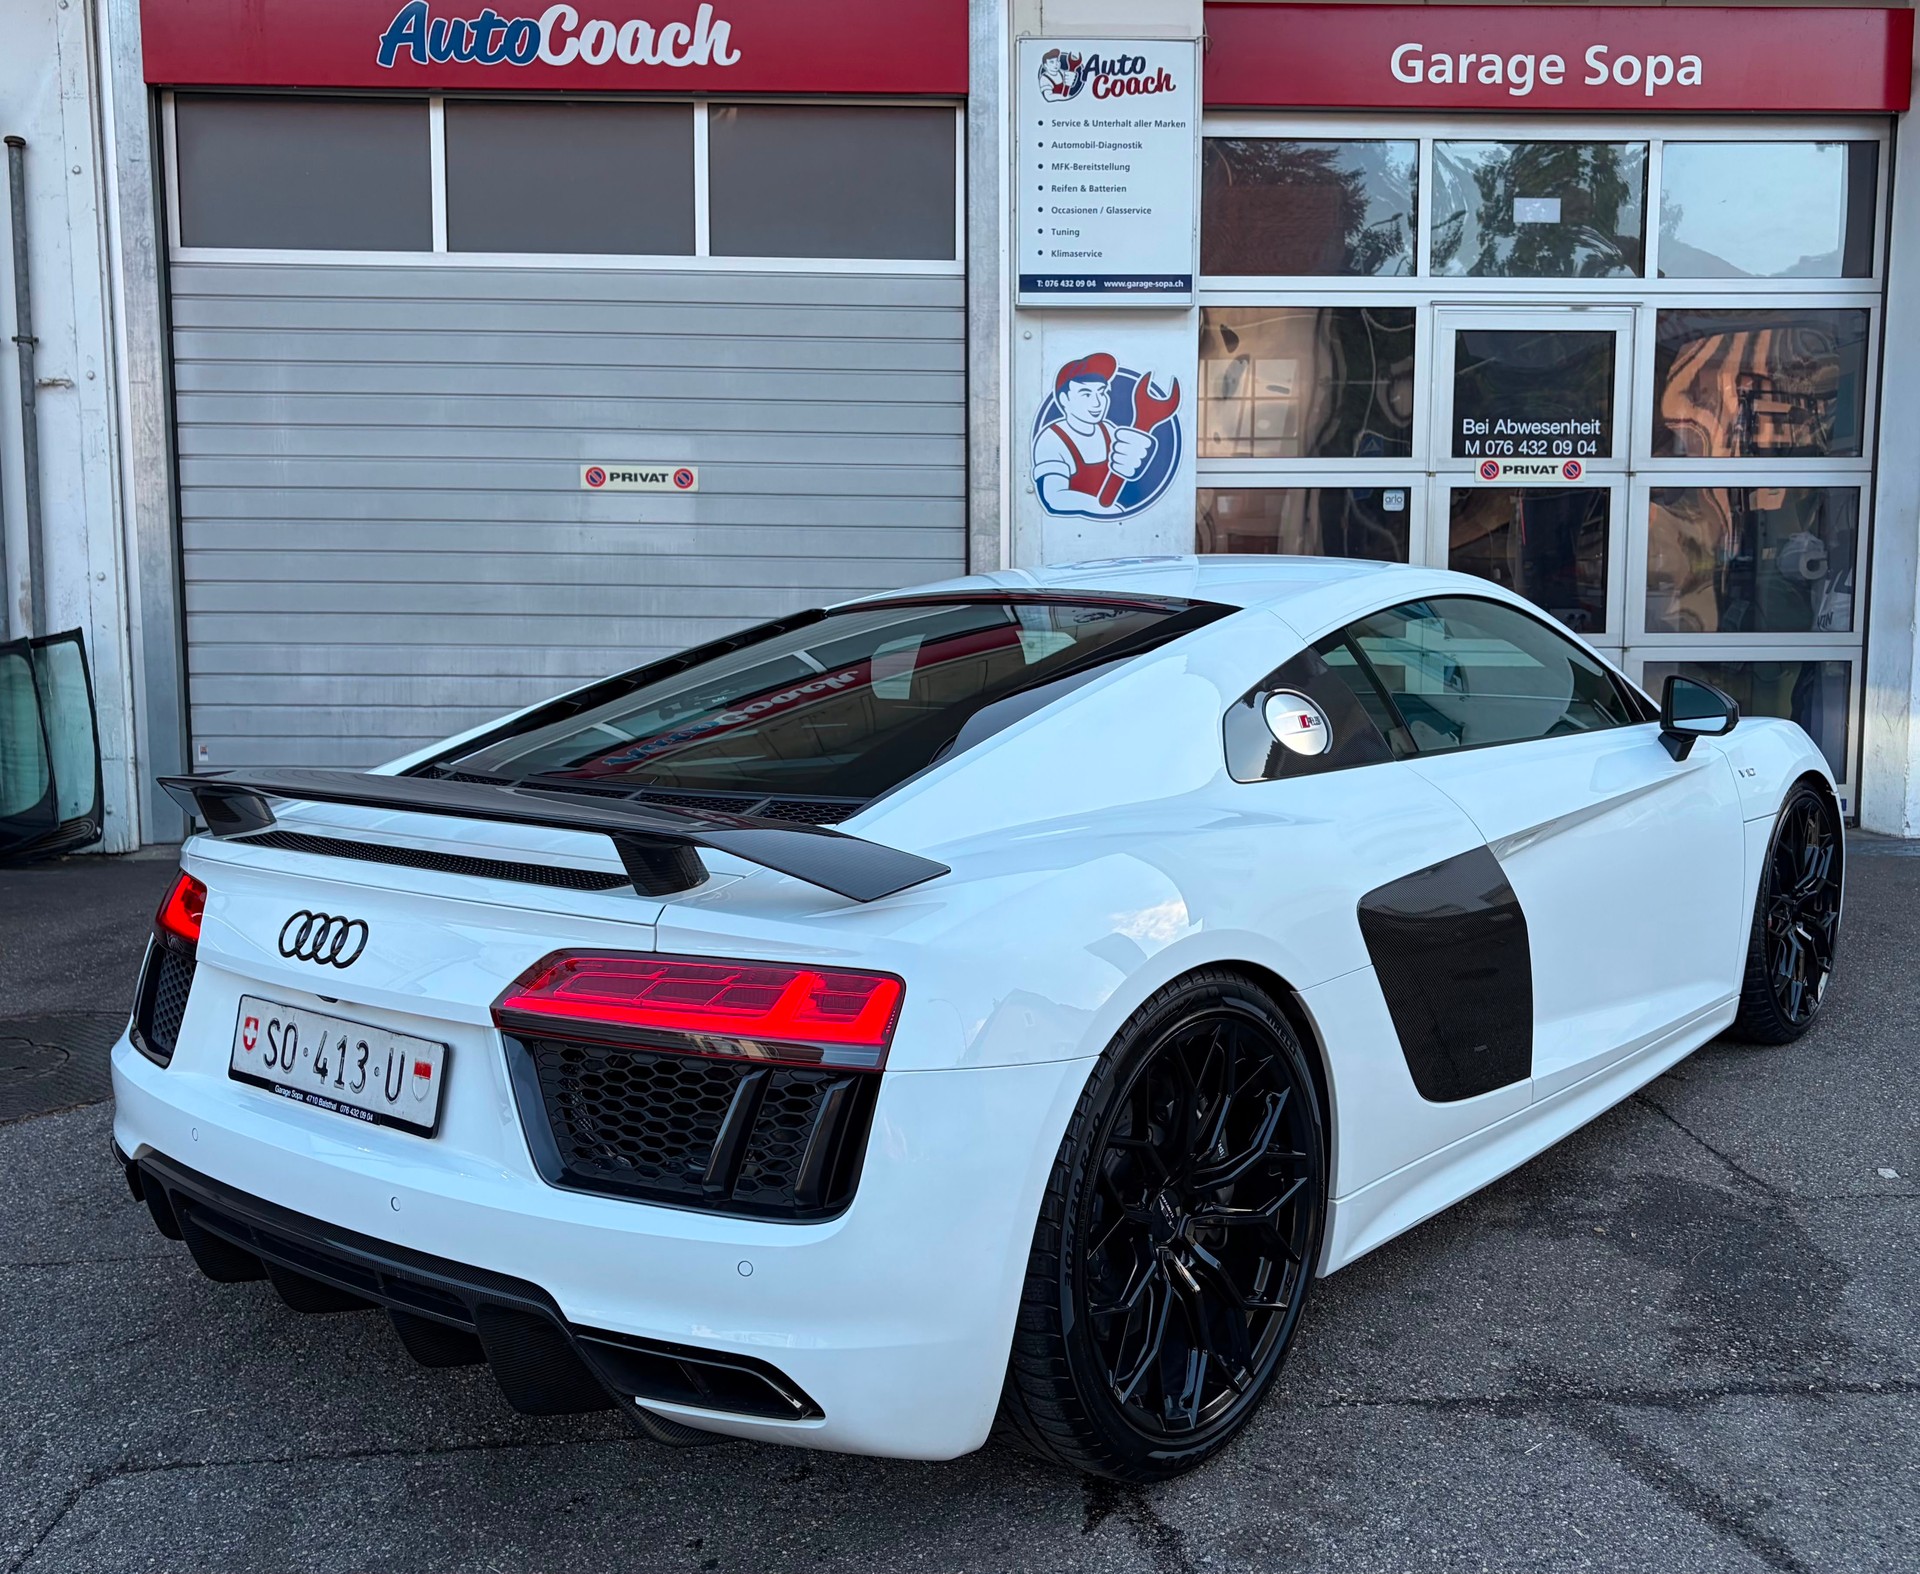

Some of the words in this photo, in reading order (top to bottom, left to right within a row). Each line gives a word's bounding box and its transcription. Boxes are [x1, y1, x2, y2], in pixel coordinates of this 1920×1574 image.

[376, 0, 741, 68] AutoCoach
[1082, 53, 1146, 82] Auto
[1390, 42, 1565, 97] Garage
[1584, 44, 1702, 97] Sopa
[1092, 67, 1176, 100] Coach
[1051, 119, 1081, 128] Service
[1083, 119, 1090, 128] &
[1092, 119, 1132, 128] Unterhalt
[1134, 119, 1152, 128] aller
[1154, 119, 1186, 128] Marken
[1051, 141, 1143, 151] Automobil-Diagnostik
[1051, 162, 1131, 173] MFK-Bereitstellung
[1051, 184, 1078, 193] Reifen
[1080, 184, 1087, 193] &
[1089, 184, 1127, 193] Batterien
[1051, 206, 1098, 215] Occasionen
[1106, 206, 1152, 215] Glasservice
[1051, 228, 1080, 237] Tuning
[1051, 249, 1103, 258] Klimaservice
[1036, 279, 1044, 288] T:
[1045, 279, 1059, 288] 076
[1060, 279, 1074, 288] 432
[1076, 279, 1085, 288] 09
[1086, 279, 1097, 288] 04
[1103, 280, 1184, 289] www.garage-sopa.ch
[1463, 419, 1489, 435] Bei
[1494, 419, 1601, 435] Abwesenheit
[1465, 440, 1480, 455] M
[1485, 440, 1514, 455] 076
[1518, 440, 1547, 455] 432
[1552, 440, 1572, 455] 09
[1577, 440, 1597, 455] 04
[1502, 465, 1559, 475] PRIVAT
[609, 472, 669, 483] PRIVAT
[1737, 767, 1757, 778] V10
[274, 1085, 291, 1097] Garage
[291, 1090, 303, 1101] Sopa
[306, 1095, 319, 1105] 4710
[319, 1098, 338, 1111] Balsthal
[340, 1105, 350, 1114] 076
[350, 1108, 360, 1118] 432
[360, 1110, 367, 1120] 09
[367, 1112, 374, 1121] 04
